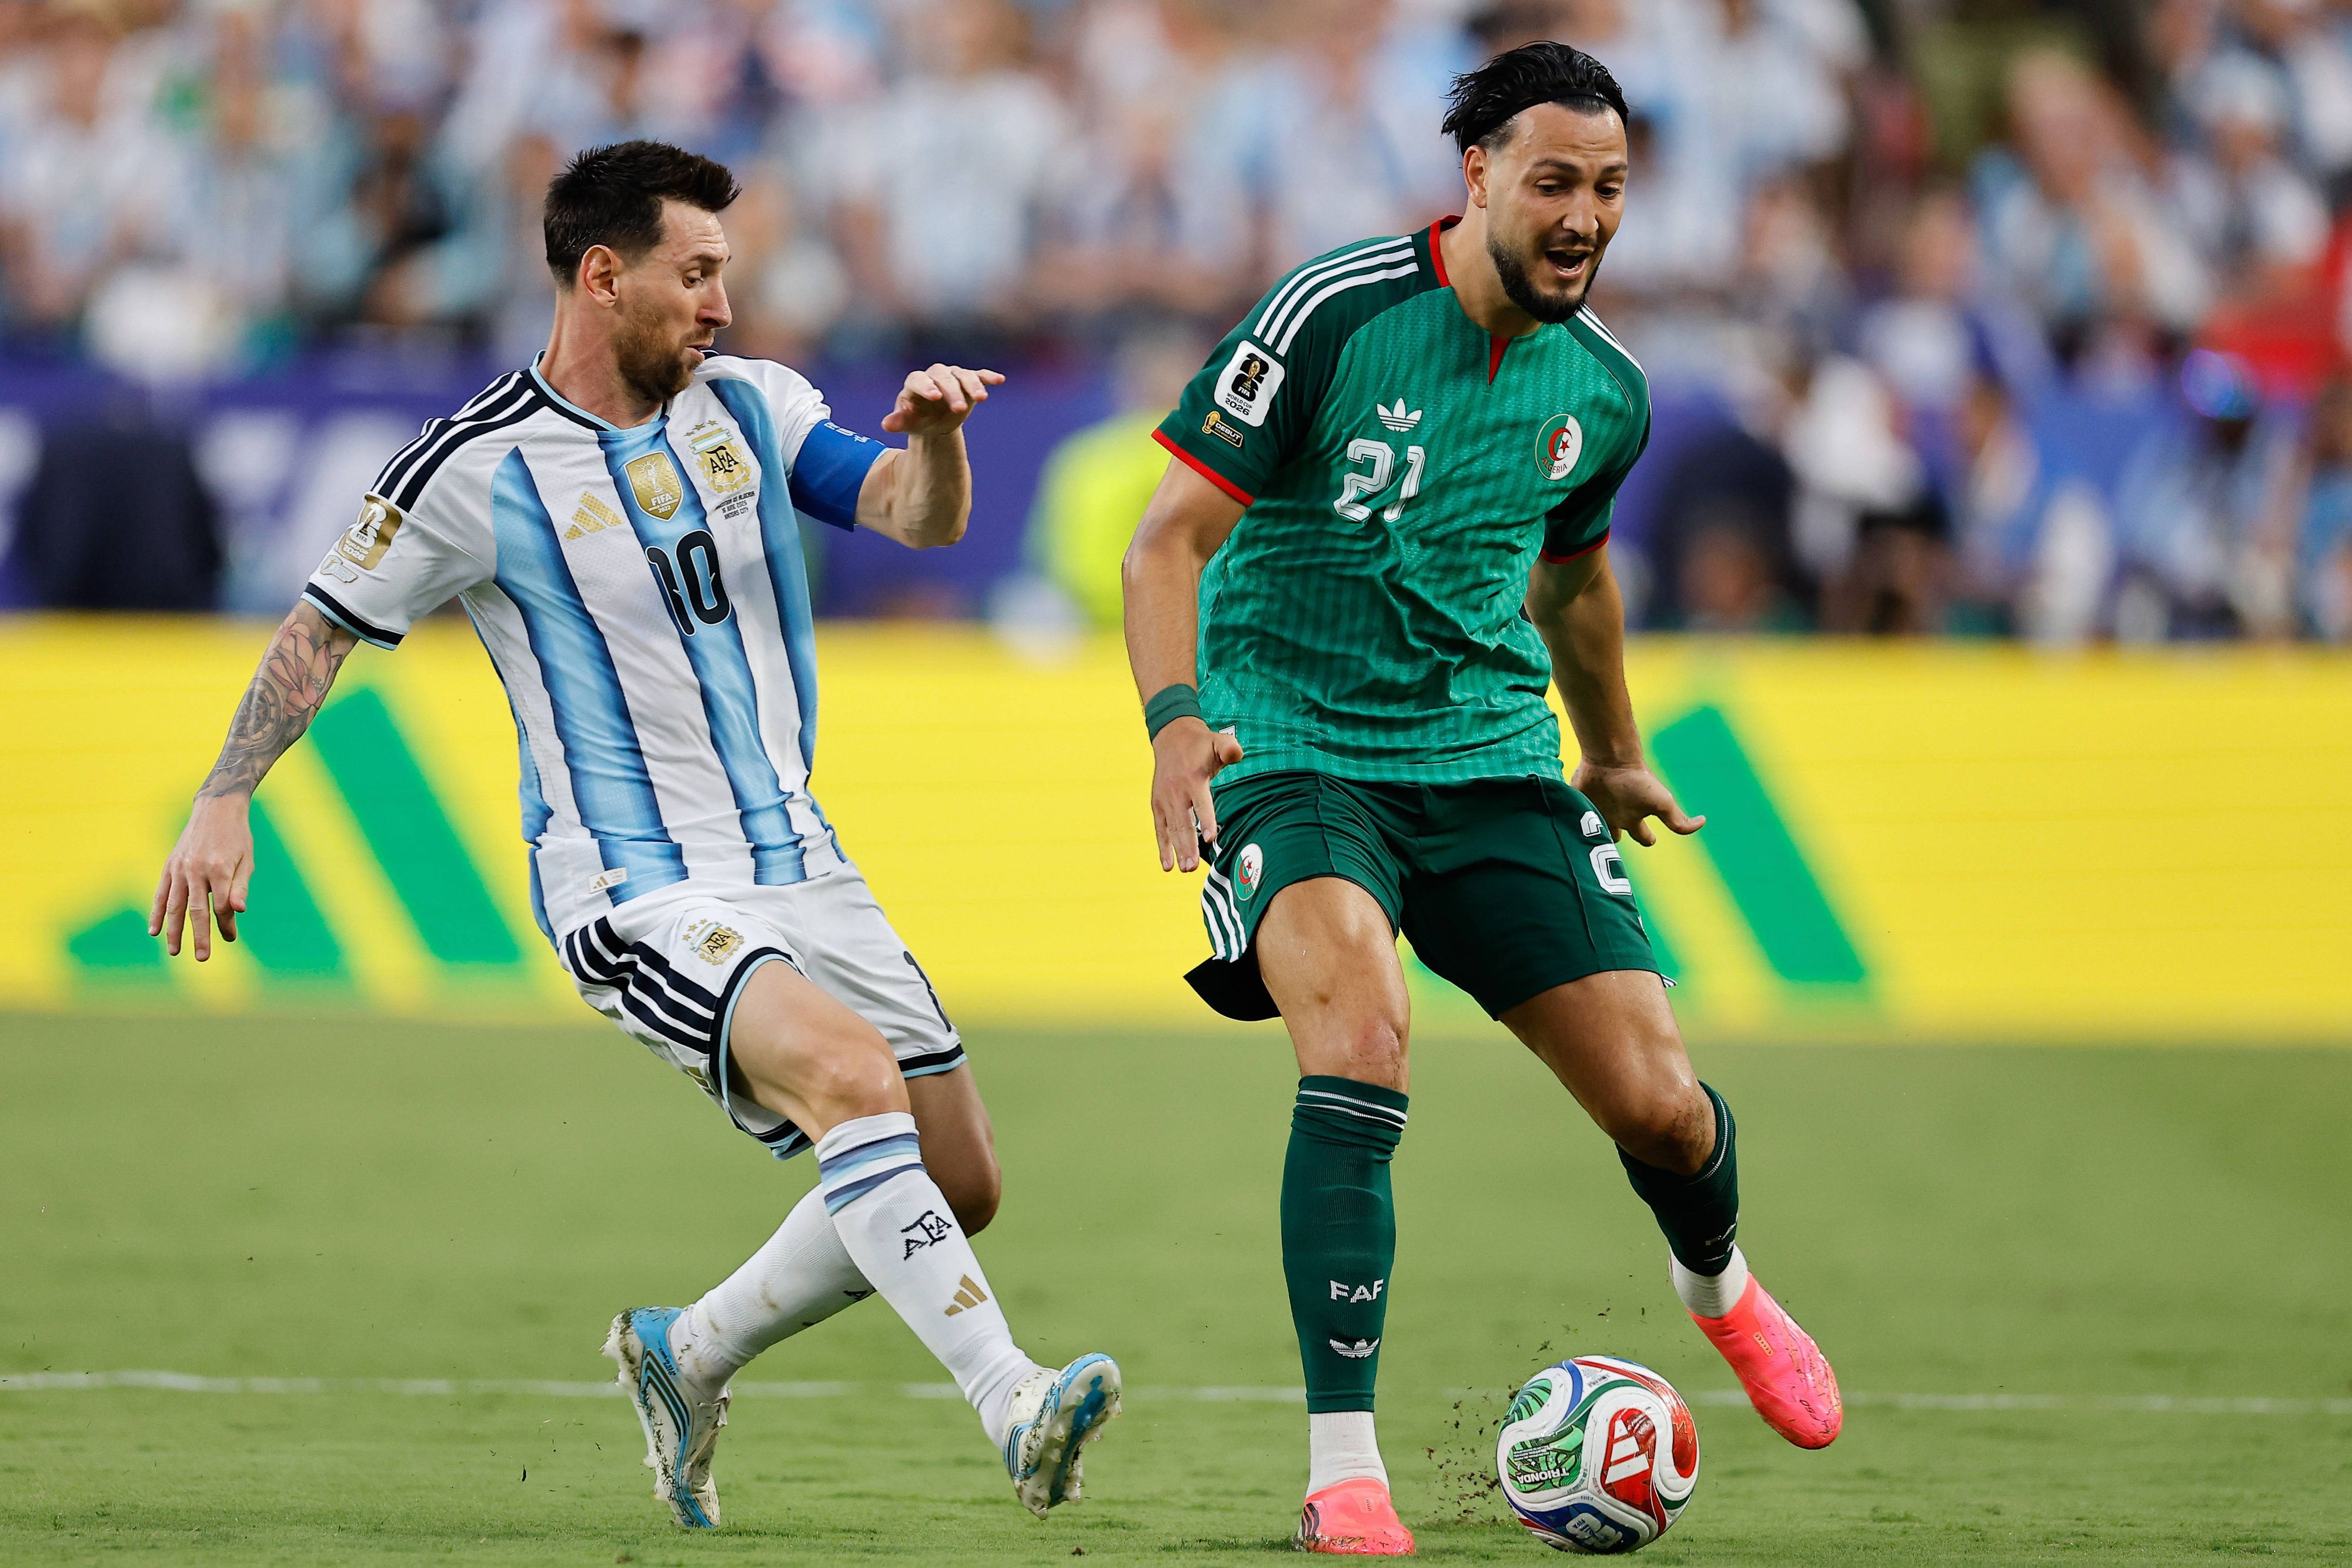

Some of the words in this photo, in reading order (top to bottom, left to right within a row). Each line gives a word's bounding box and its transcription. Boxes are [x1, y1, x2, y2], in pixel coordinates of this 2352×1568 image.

[1227, 393, 1244, 405] WORLD
[1238, 386, 1250, 397] FIFA
[1225, 398, 1250, 416] 2026
[1215, 422, 1241, 440] DEBUT
[706, 446, 739, 473] AFA
[1542, 457, 1568, 473] ALGERIA
[1333, 438, 1426, 523] 21
[651, 493, 673, 506] FIFA
[740, 507, 749, 515] CITY
[356, 533, 368, 543] FIFA
[343, 544, 366, 561] 2026
[359, 547, 369, 555] CUP
[645, 529, 732, 637] 10
[702, 932, 731, 954] AFA
[900, 1210, 953, 1261] AFA
[1330, 1279, 1384, 1303] FAF
[1516, 1466, 1570, 1485] TRIONDA
